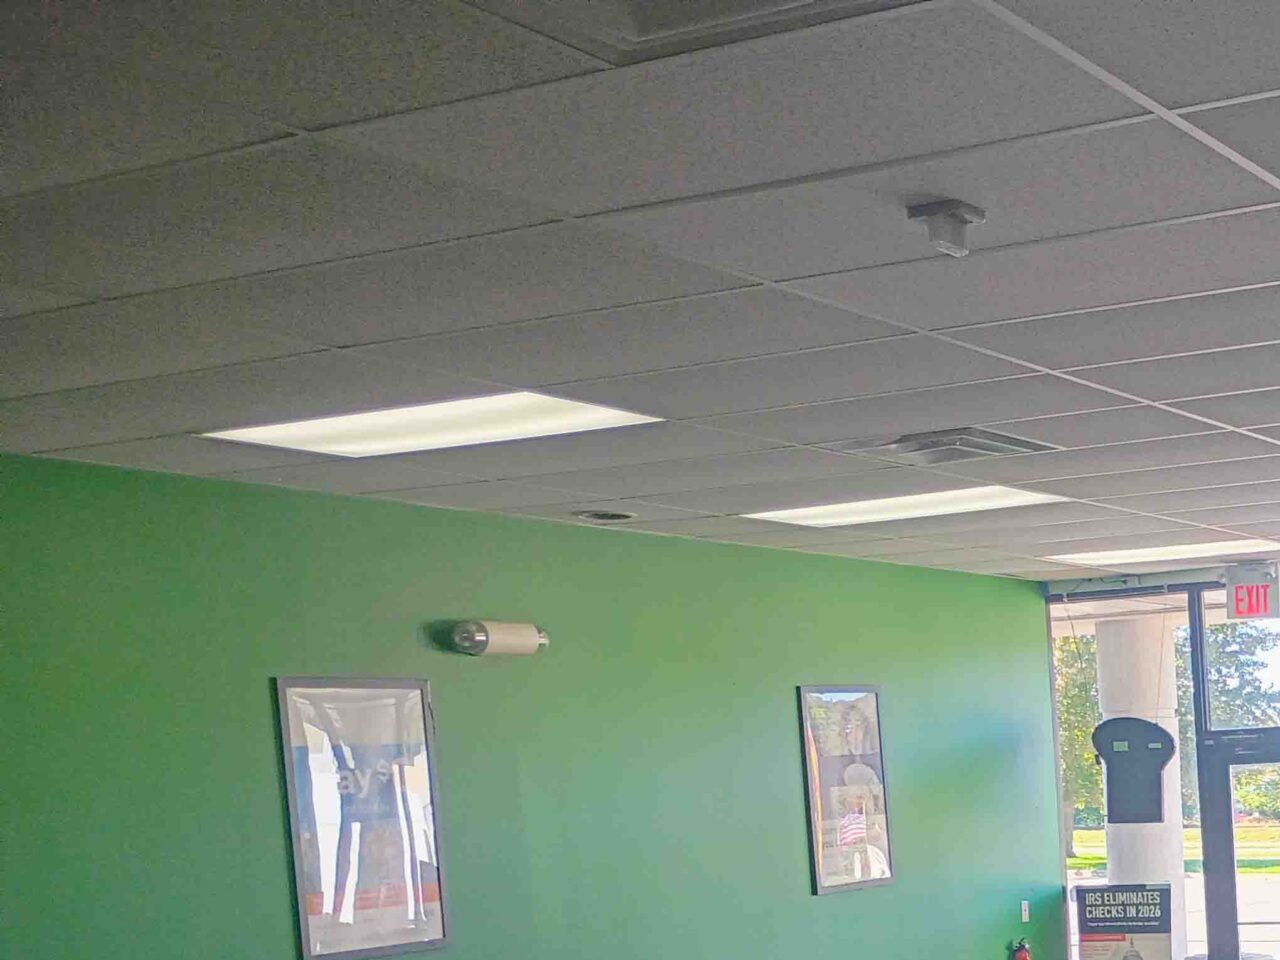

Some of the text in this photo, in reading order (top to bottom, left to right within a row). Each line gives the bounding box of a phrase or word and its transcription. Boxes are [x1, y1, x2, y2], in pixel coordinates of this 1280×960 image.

[1235, 584, 1269, 616] EXIT
[1086, 891, 1160, 905] IRS ELIMINATES
[1086, 905, 1161, 918] CHECKS IN 2026
